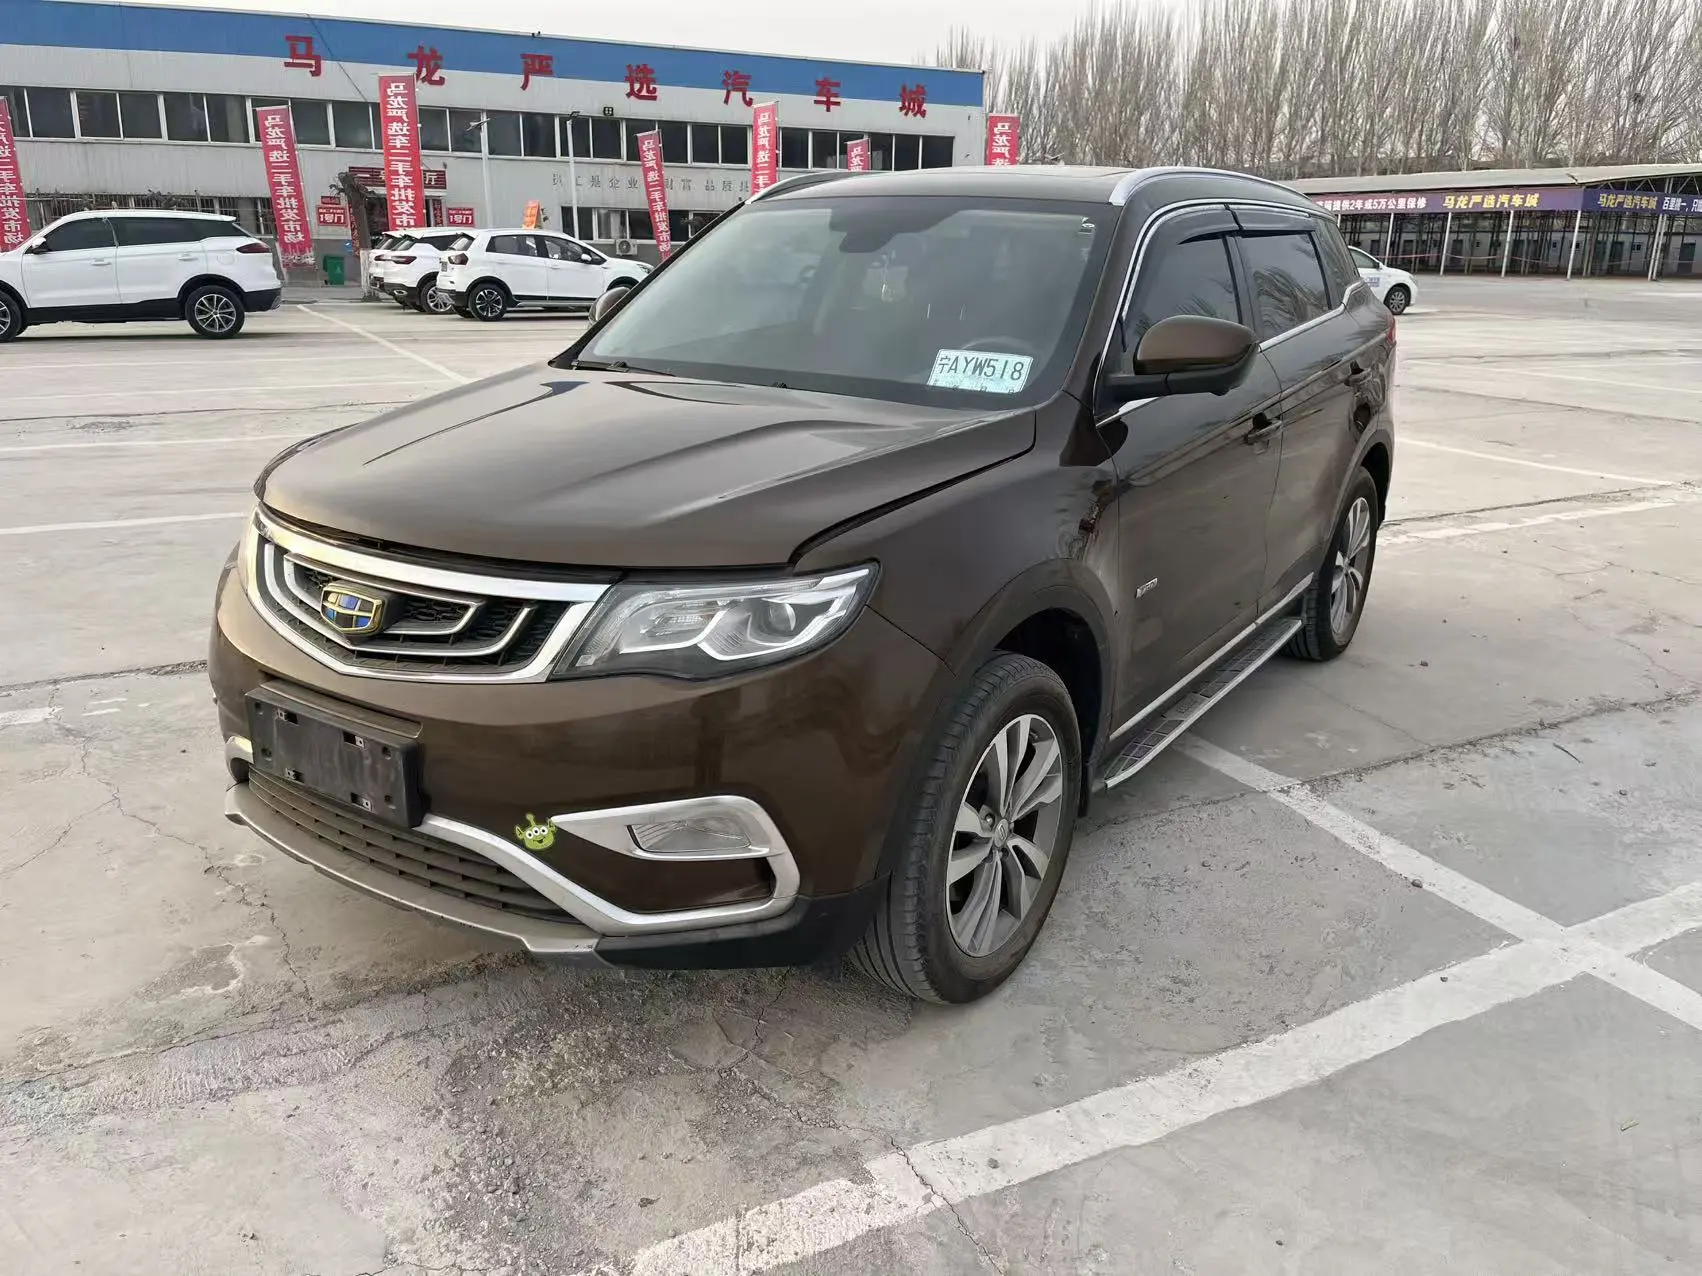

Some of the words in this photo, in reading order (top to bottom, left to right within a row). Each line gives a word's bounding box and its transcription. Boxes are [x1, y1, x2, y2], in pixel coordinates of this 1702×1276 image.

[284, 35, 926, 118] 马龙严选汽车城
[1442, 193, 1540, 209] 马龙严选汽车城
[939, 355, 1025, 381] 宁AYW518
